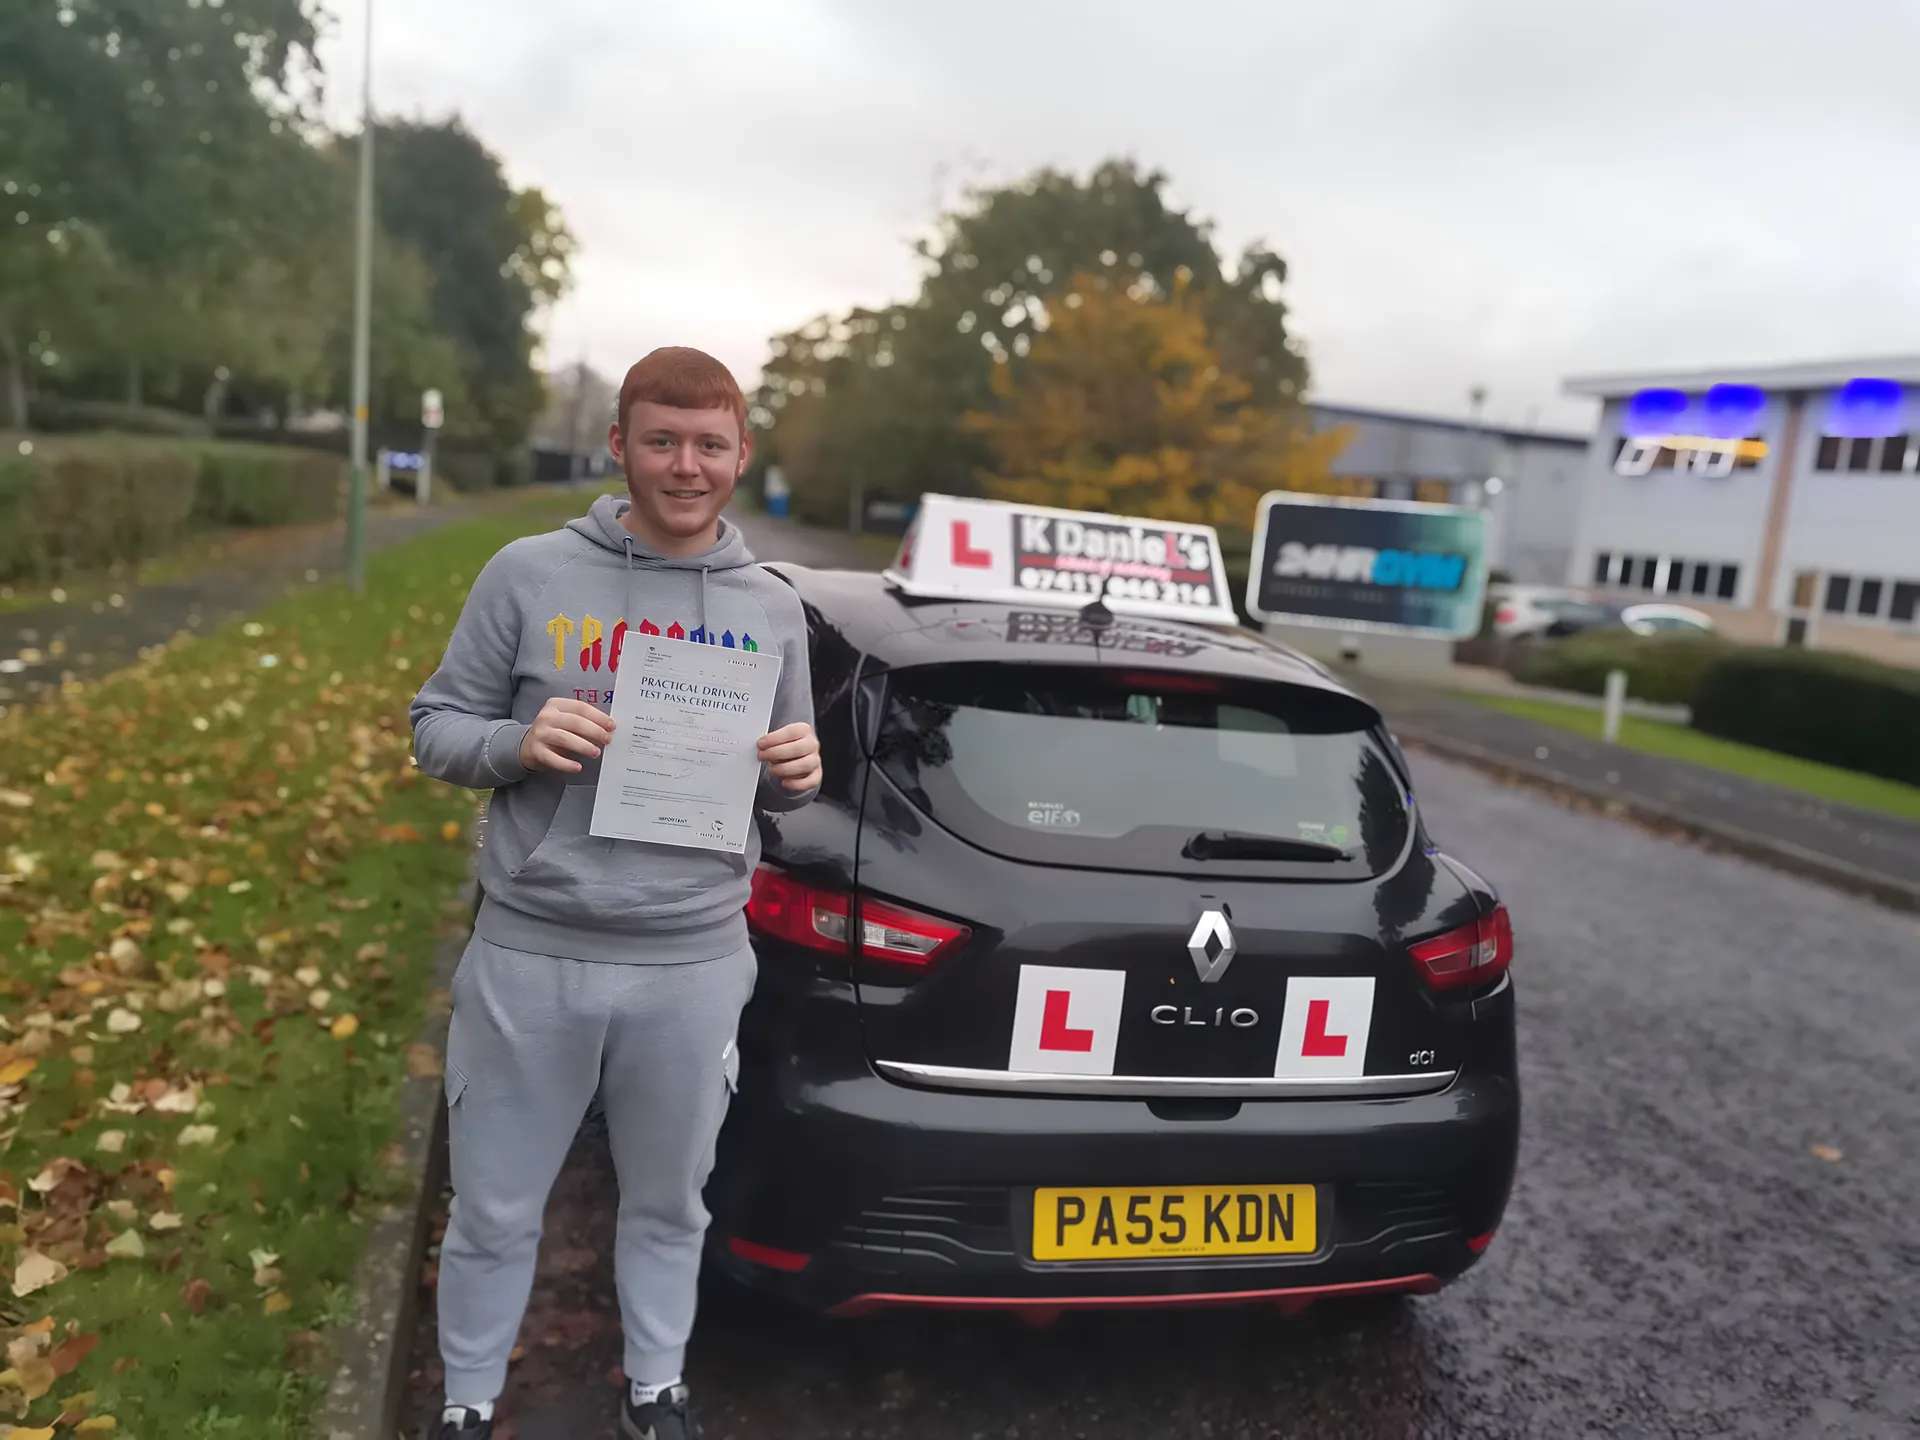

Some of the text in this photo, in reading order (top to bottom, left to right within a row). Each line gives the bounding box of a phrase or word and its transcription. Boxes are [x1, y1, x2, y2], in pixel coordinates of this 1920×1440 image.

[951, 520, 992, 569] L
[1020, 515, 1052, 554] K
[640, 688, 661, 700] TEST
[664, 693, 687, 704] PASS
[689, 697, 748, 714] CERTIFICATE
[641, 676, 750, 702] PRACTICAL DRIVING
[1039, 990, 1094, 1052] L
[1150, 1005, 1259, 1027] CLIO
[1301, 1000, 1348, 1056] L
[1409, 1050, 1435, 1065] dCi
[1203, 1193, 1294, 1244] KDN
